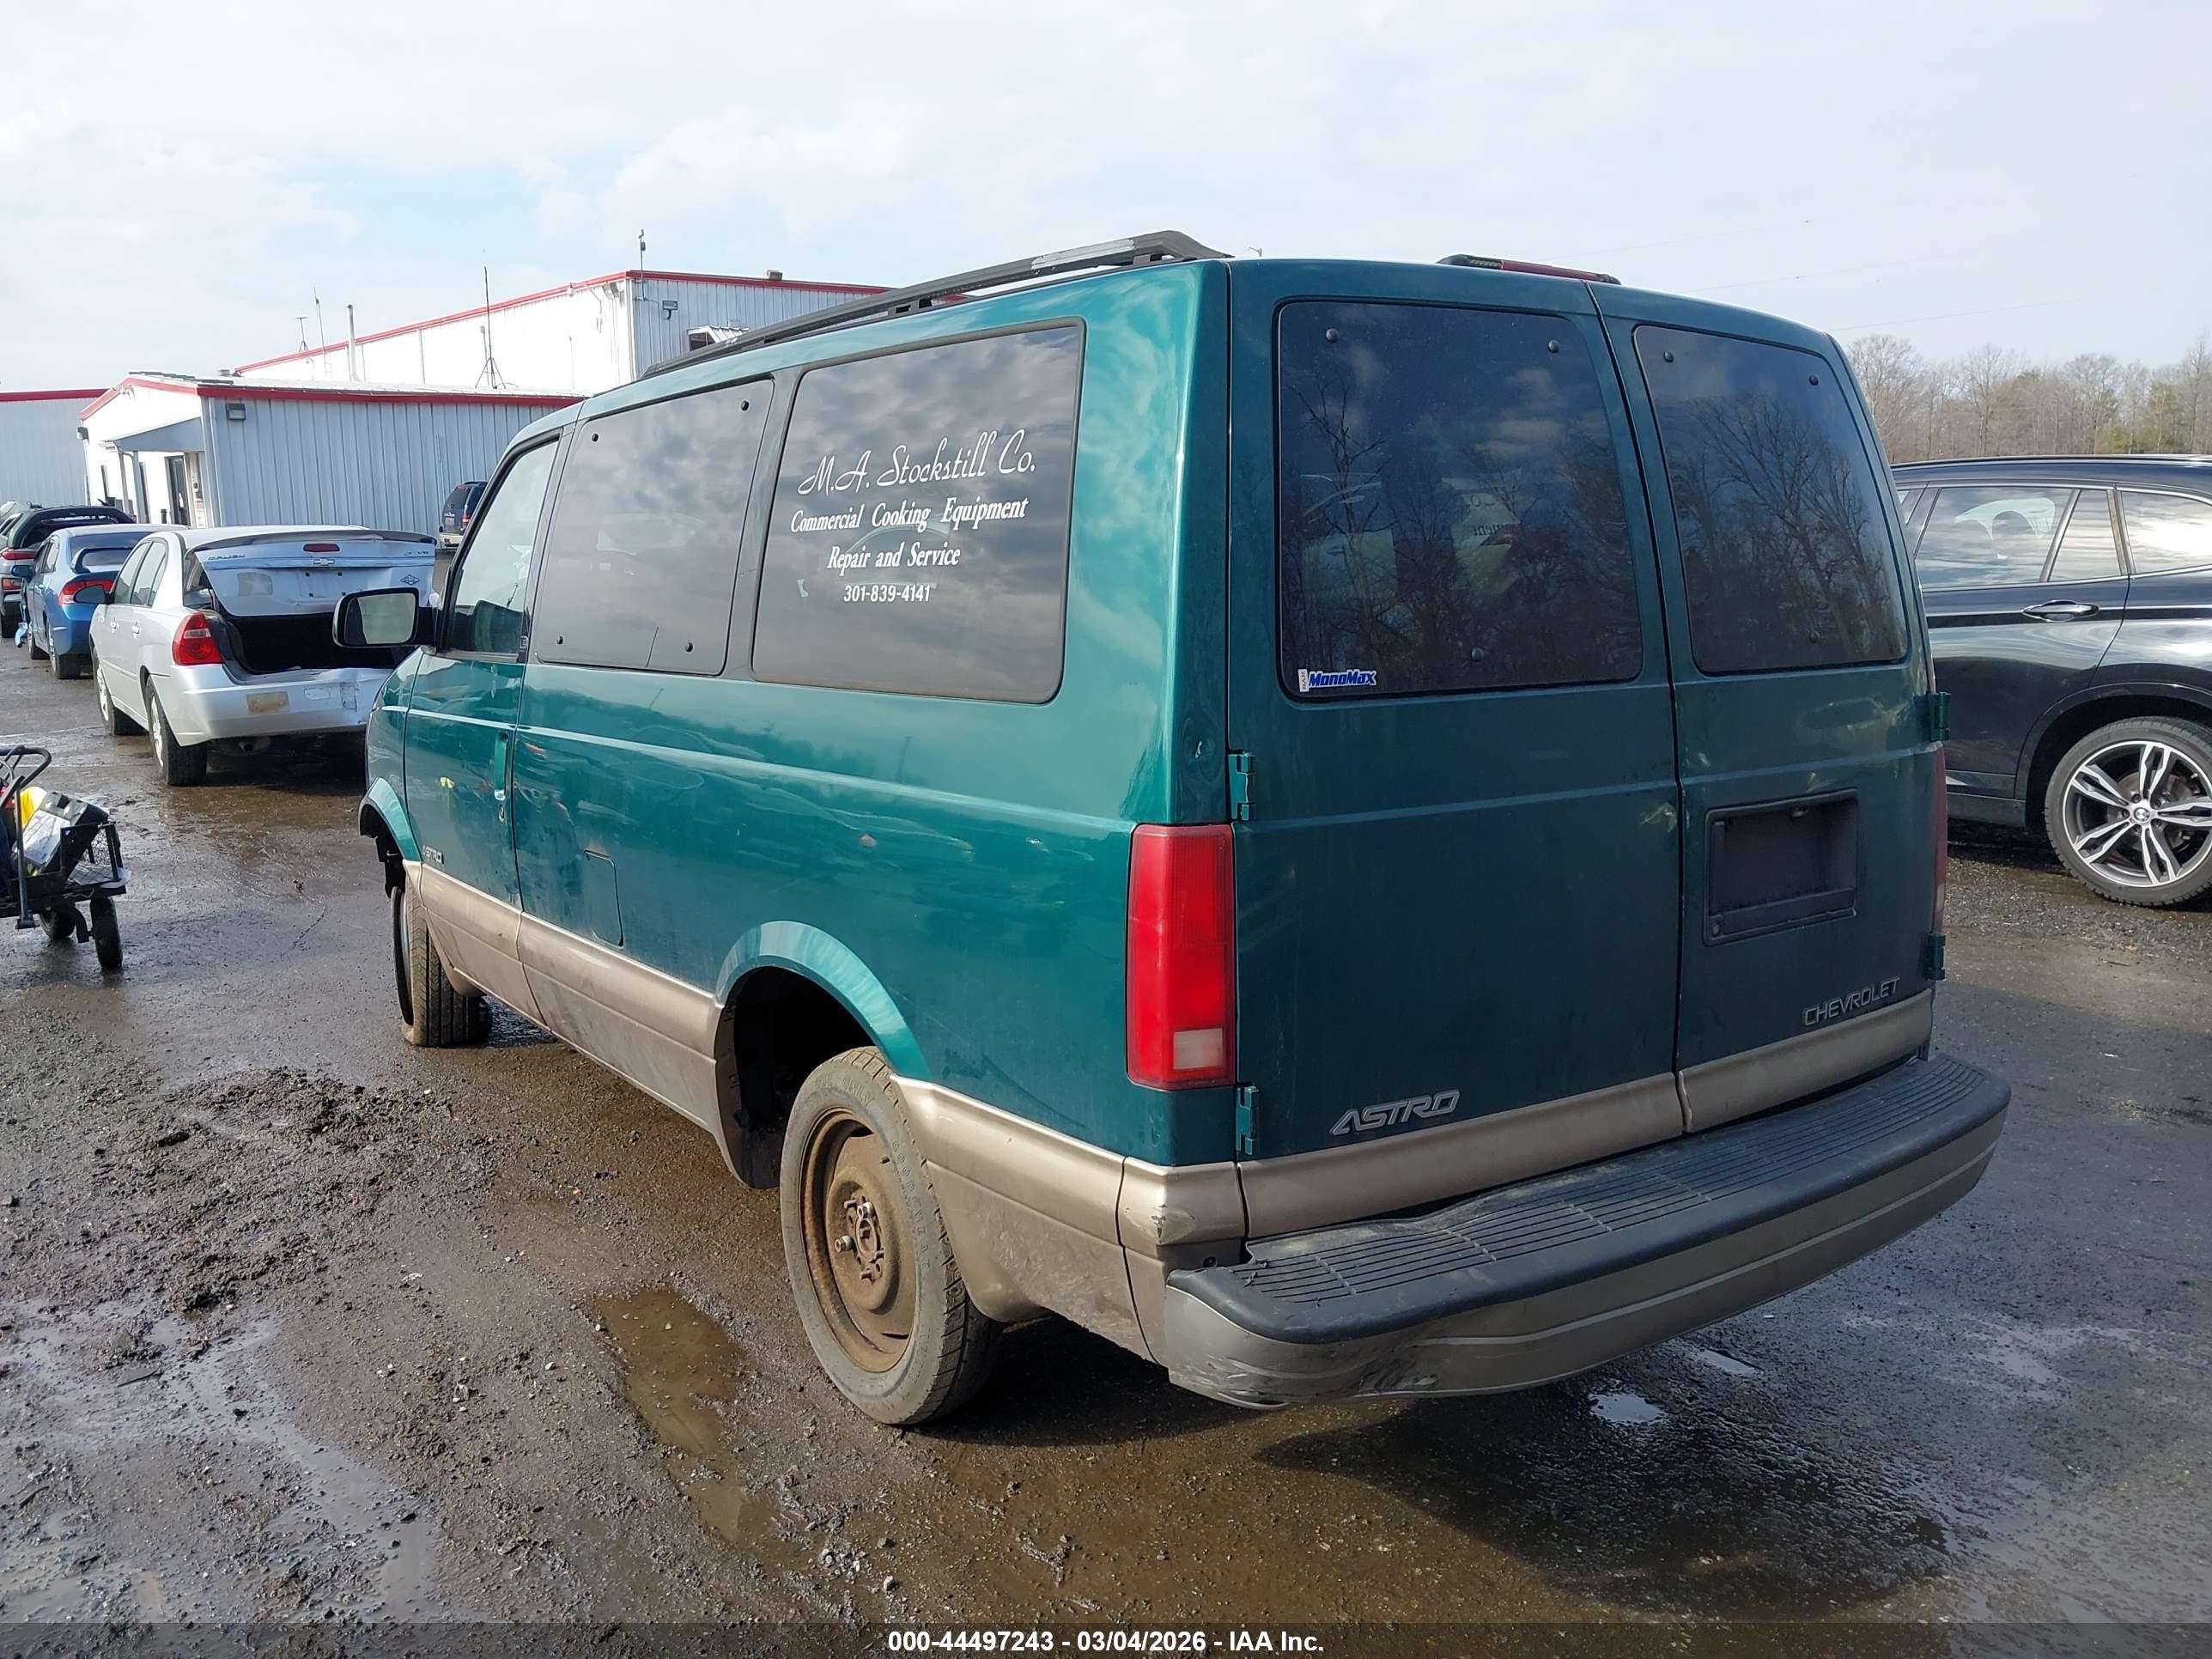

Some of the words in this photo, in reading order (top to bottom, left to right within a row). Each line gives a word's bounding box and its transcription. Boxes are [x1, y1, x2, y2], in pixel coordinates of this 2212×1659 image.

[877, 430, 997, 488] Stockstill
[998, 428, 1036, 474] Co.
[791, 503, 863, 533] Commercial
[872, 500, 932, 533] Cooking
[940, 495, 1030, 531] Equipment
[827, 544, 871, 576] Repair
[875, 542, 904, 568] and
[907, 541, 961, 568] Service
[843, 584, 931, 603] 301-839-4141
[1309, 670, 1376, 687] MonoMax
[1803, 975, 1900, 1026] CHEVROLET
[1330, 1088, 1461, 1136] ASTRO
